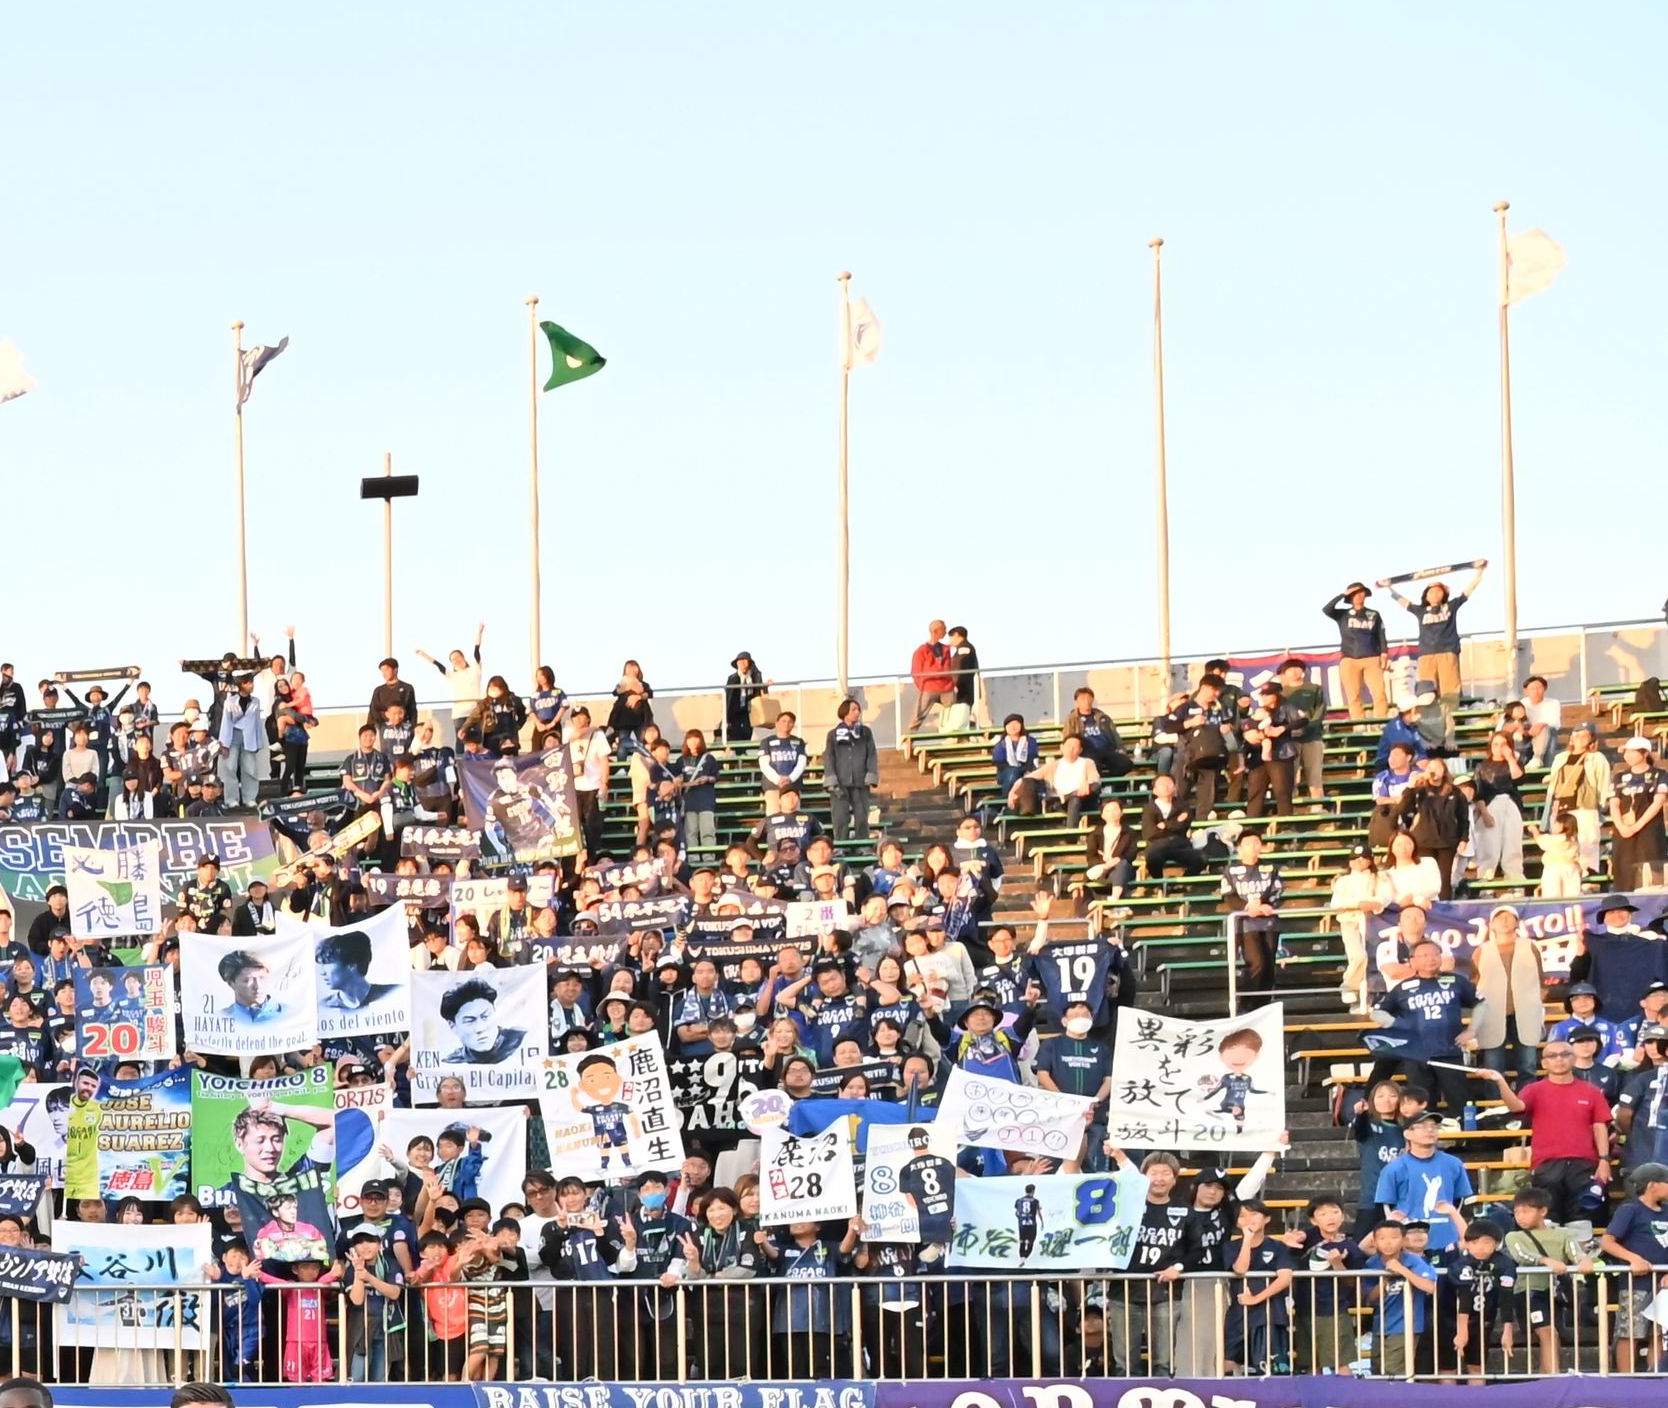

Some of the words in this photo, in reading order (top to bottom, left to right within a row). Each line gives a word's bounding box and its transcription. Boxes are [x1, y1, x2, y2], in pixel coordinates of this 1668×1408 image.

[403, 826, 423, 845] 54
[71, 848, 148, 881] 必勝
[369, 879, 387, 895] 19
[455, 888, 474, 901] 20
[76, 892, 153, 933] 徳島
[600, 903, 622, 921] 54
[532, 944, 554, 963] 20
[704, 942, 767, 956] TOKUSHIMA
[1056, 956, 1095, 992] 19
[340, 1016, 358, 1030] del
[362, 1011, 406, 1027] viento
[1424, 1005, 1442, 1020] 12
[194, 1017, 236, 1034] HAYATE
[84, 1023, 139, 1056] 20
[234, 1034, 263, 1050] defend
[265, 1034, 282, 1049] the
[1128, 1017, 1215, 1056] 異彩
[417, 1050, 441, 1069] KEN
[1159, 1054, 1182, 1083] を
[198, 1071, 305, 1090] YOICHIRO
[313, 1067, 326, 1083] 8
[470, 1070, 483, 1087] El
[545, 1070, 568, 1089] 28
[100, 1094, 152, 1112] JOSE
[626, 1047, 677, 1163] 鹿沼直生
[1121, 1079, 1187, 1115] 放て
[99, 1111, 191, 1131] AURELIO
[1194, 1122, 1226, 1142] 20
[97, 1132, 183, 1152] SUAREZ
[772, 1132, 838, 1168] 鹿沼
[108, 1171, 153, 1190] 徳島
[790, 1171, 823, 1199] 28
[871, 1166, 897, 1194] 8
[921, 1167, 941, 1195] 8
[816, 1205, 849, 1217] NAOKI
[1022, 1200, 1033, 1213] 8
[1073, 1177, 1120, 1227] 8
[1140, 1246, 1161, 1265] 19
[305, 1309, 316, 1320] 21
